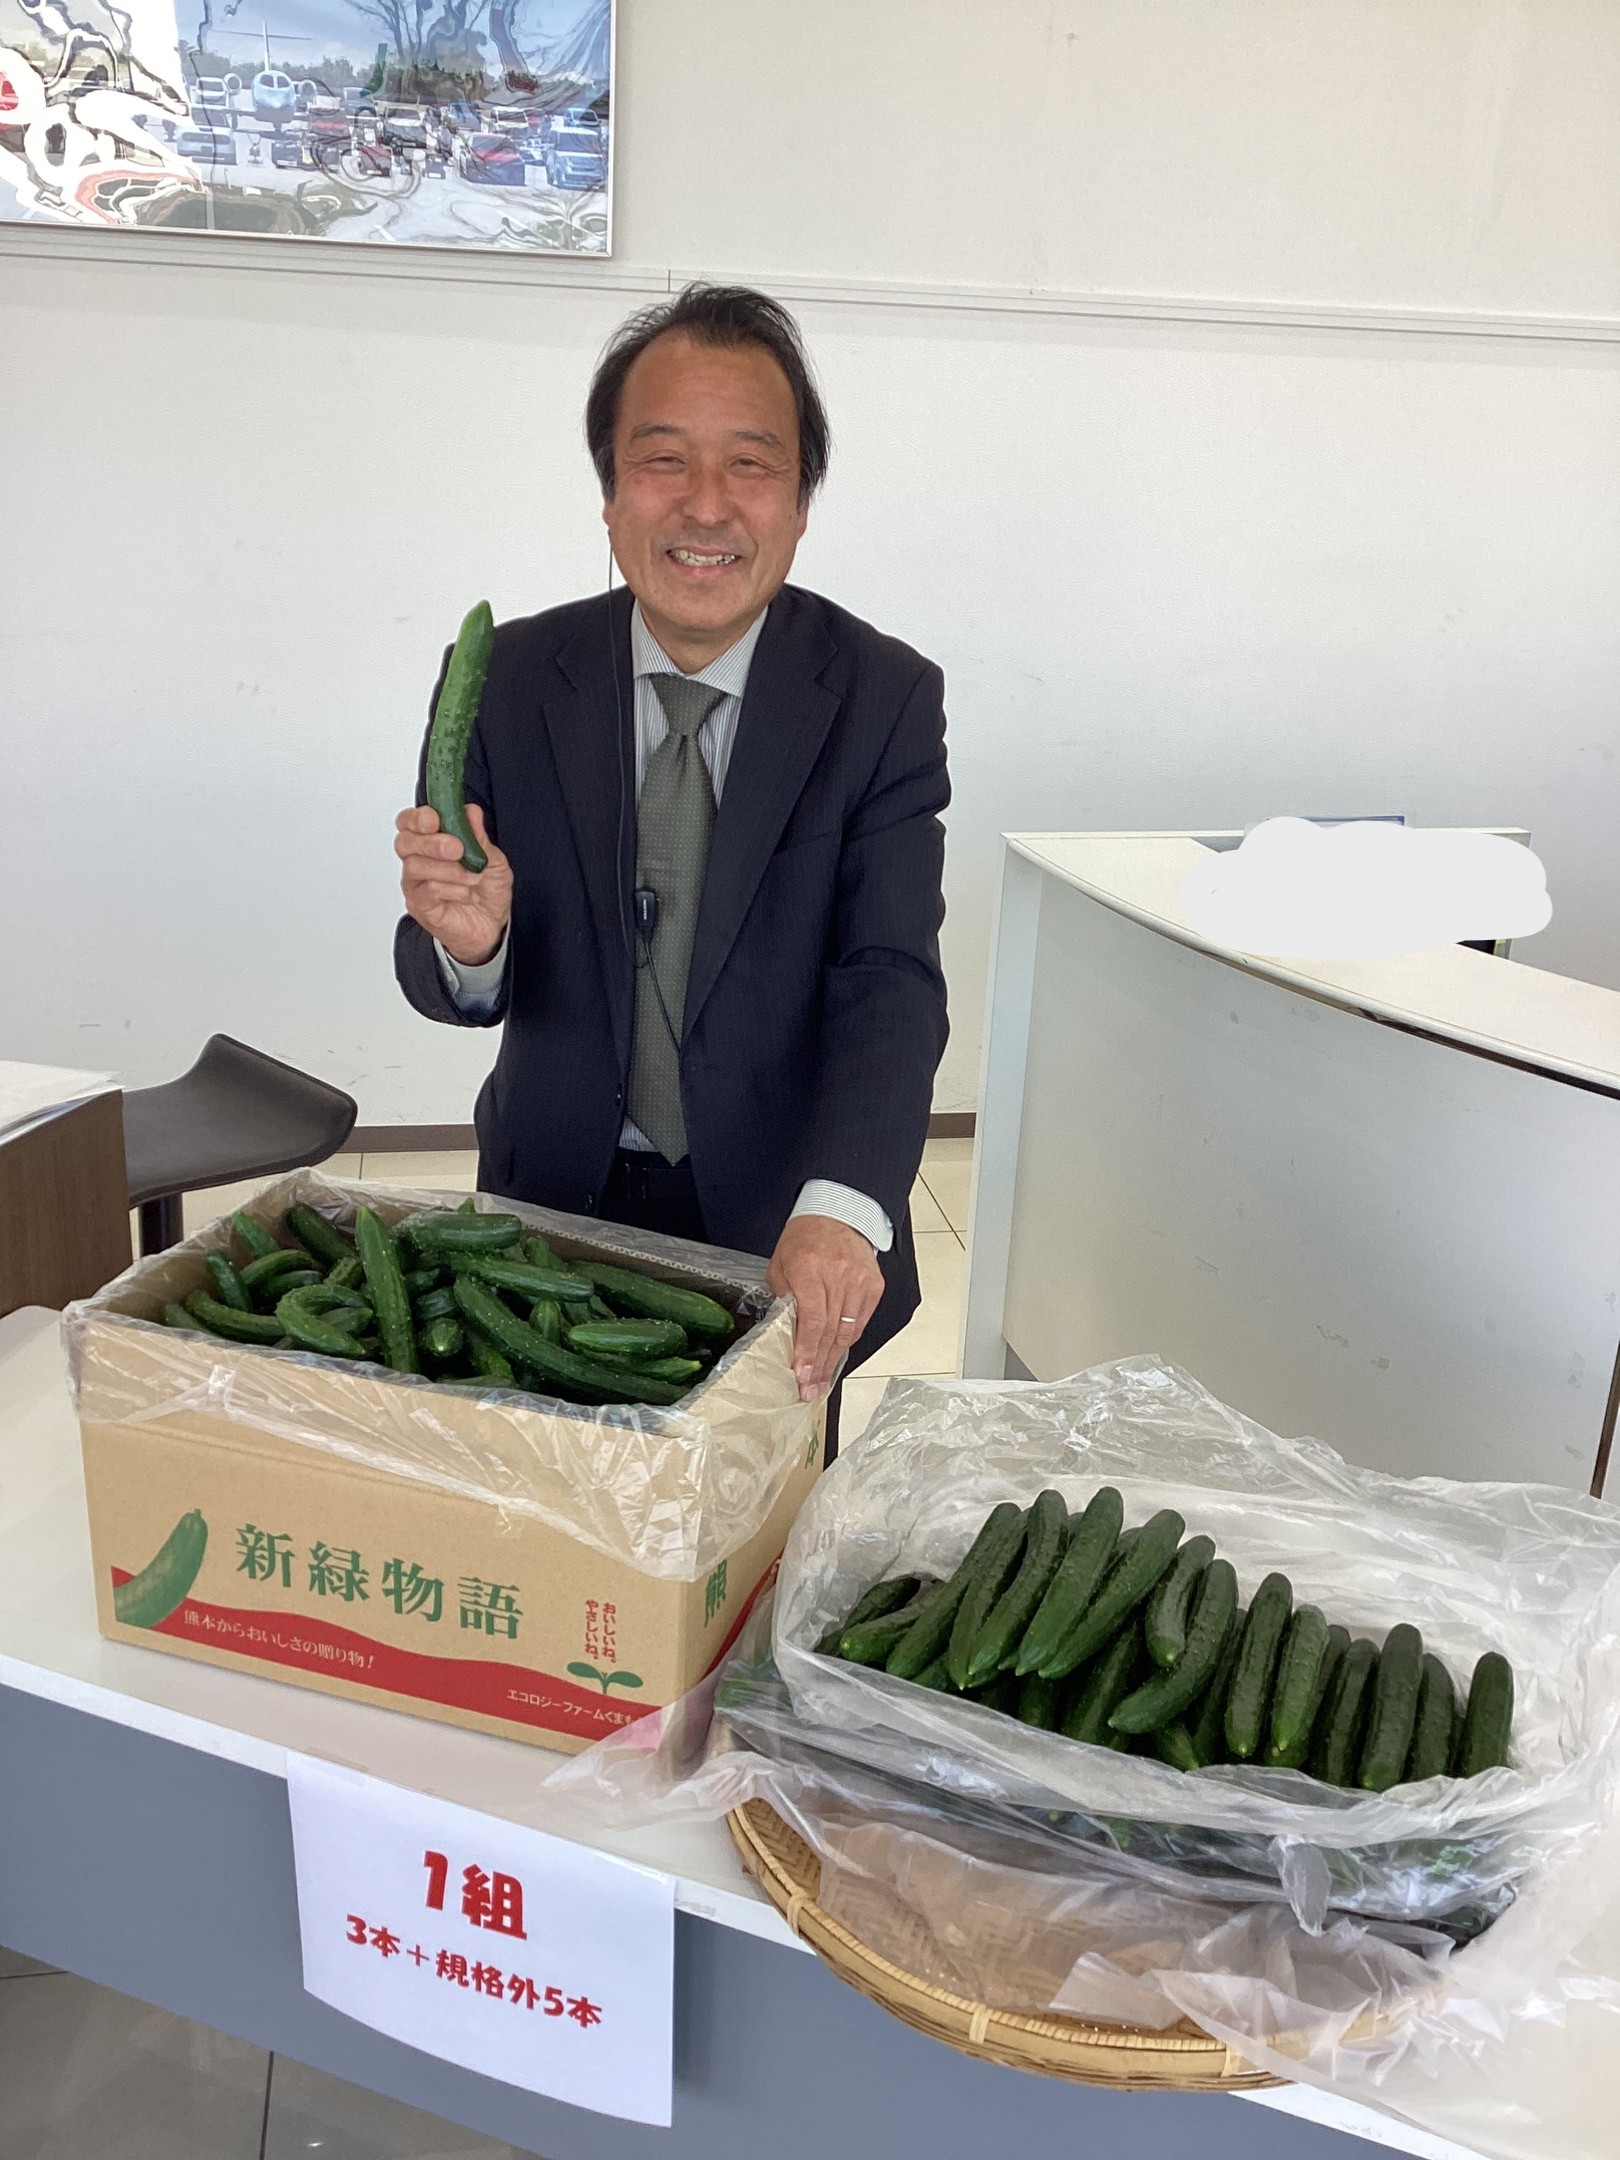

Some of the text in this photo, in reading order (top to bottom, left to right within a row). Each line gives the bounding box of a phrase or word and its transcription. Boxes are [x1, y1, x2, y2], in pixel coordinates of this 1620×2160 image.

[234, 1523, 524, 1640] 新緑物語
[584, 1599, 599, 1660] やさしいね。
[602, 1602, 616, 1664] おいしいね。
[507, 1688, 642, 1727] エコロジーファームくまも
[423, 1851, 528, 1941] 1組
